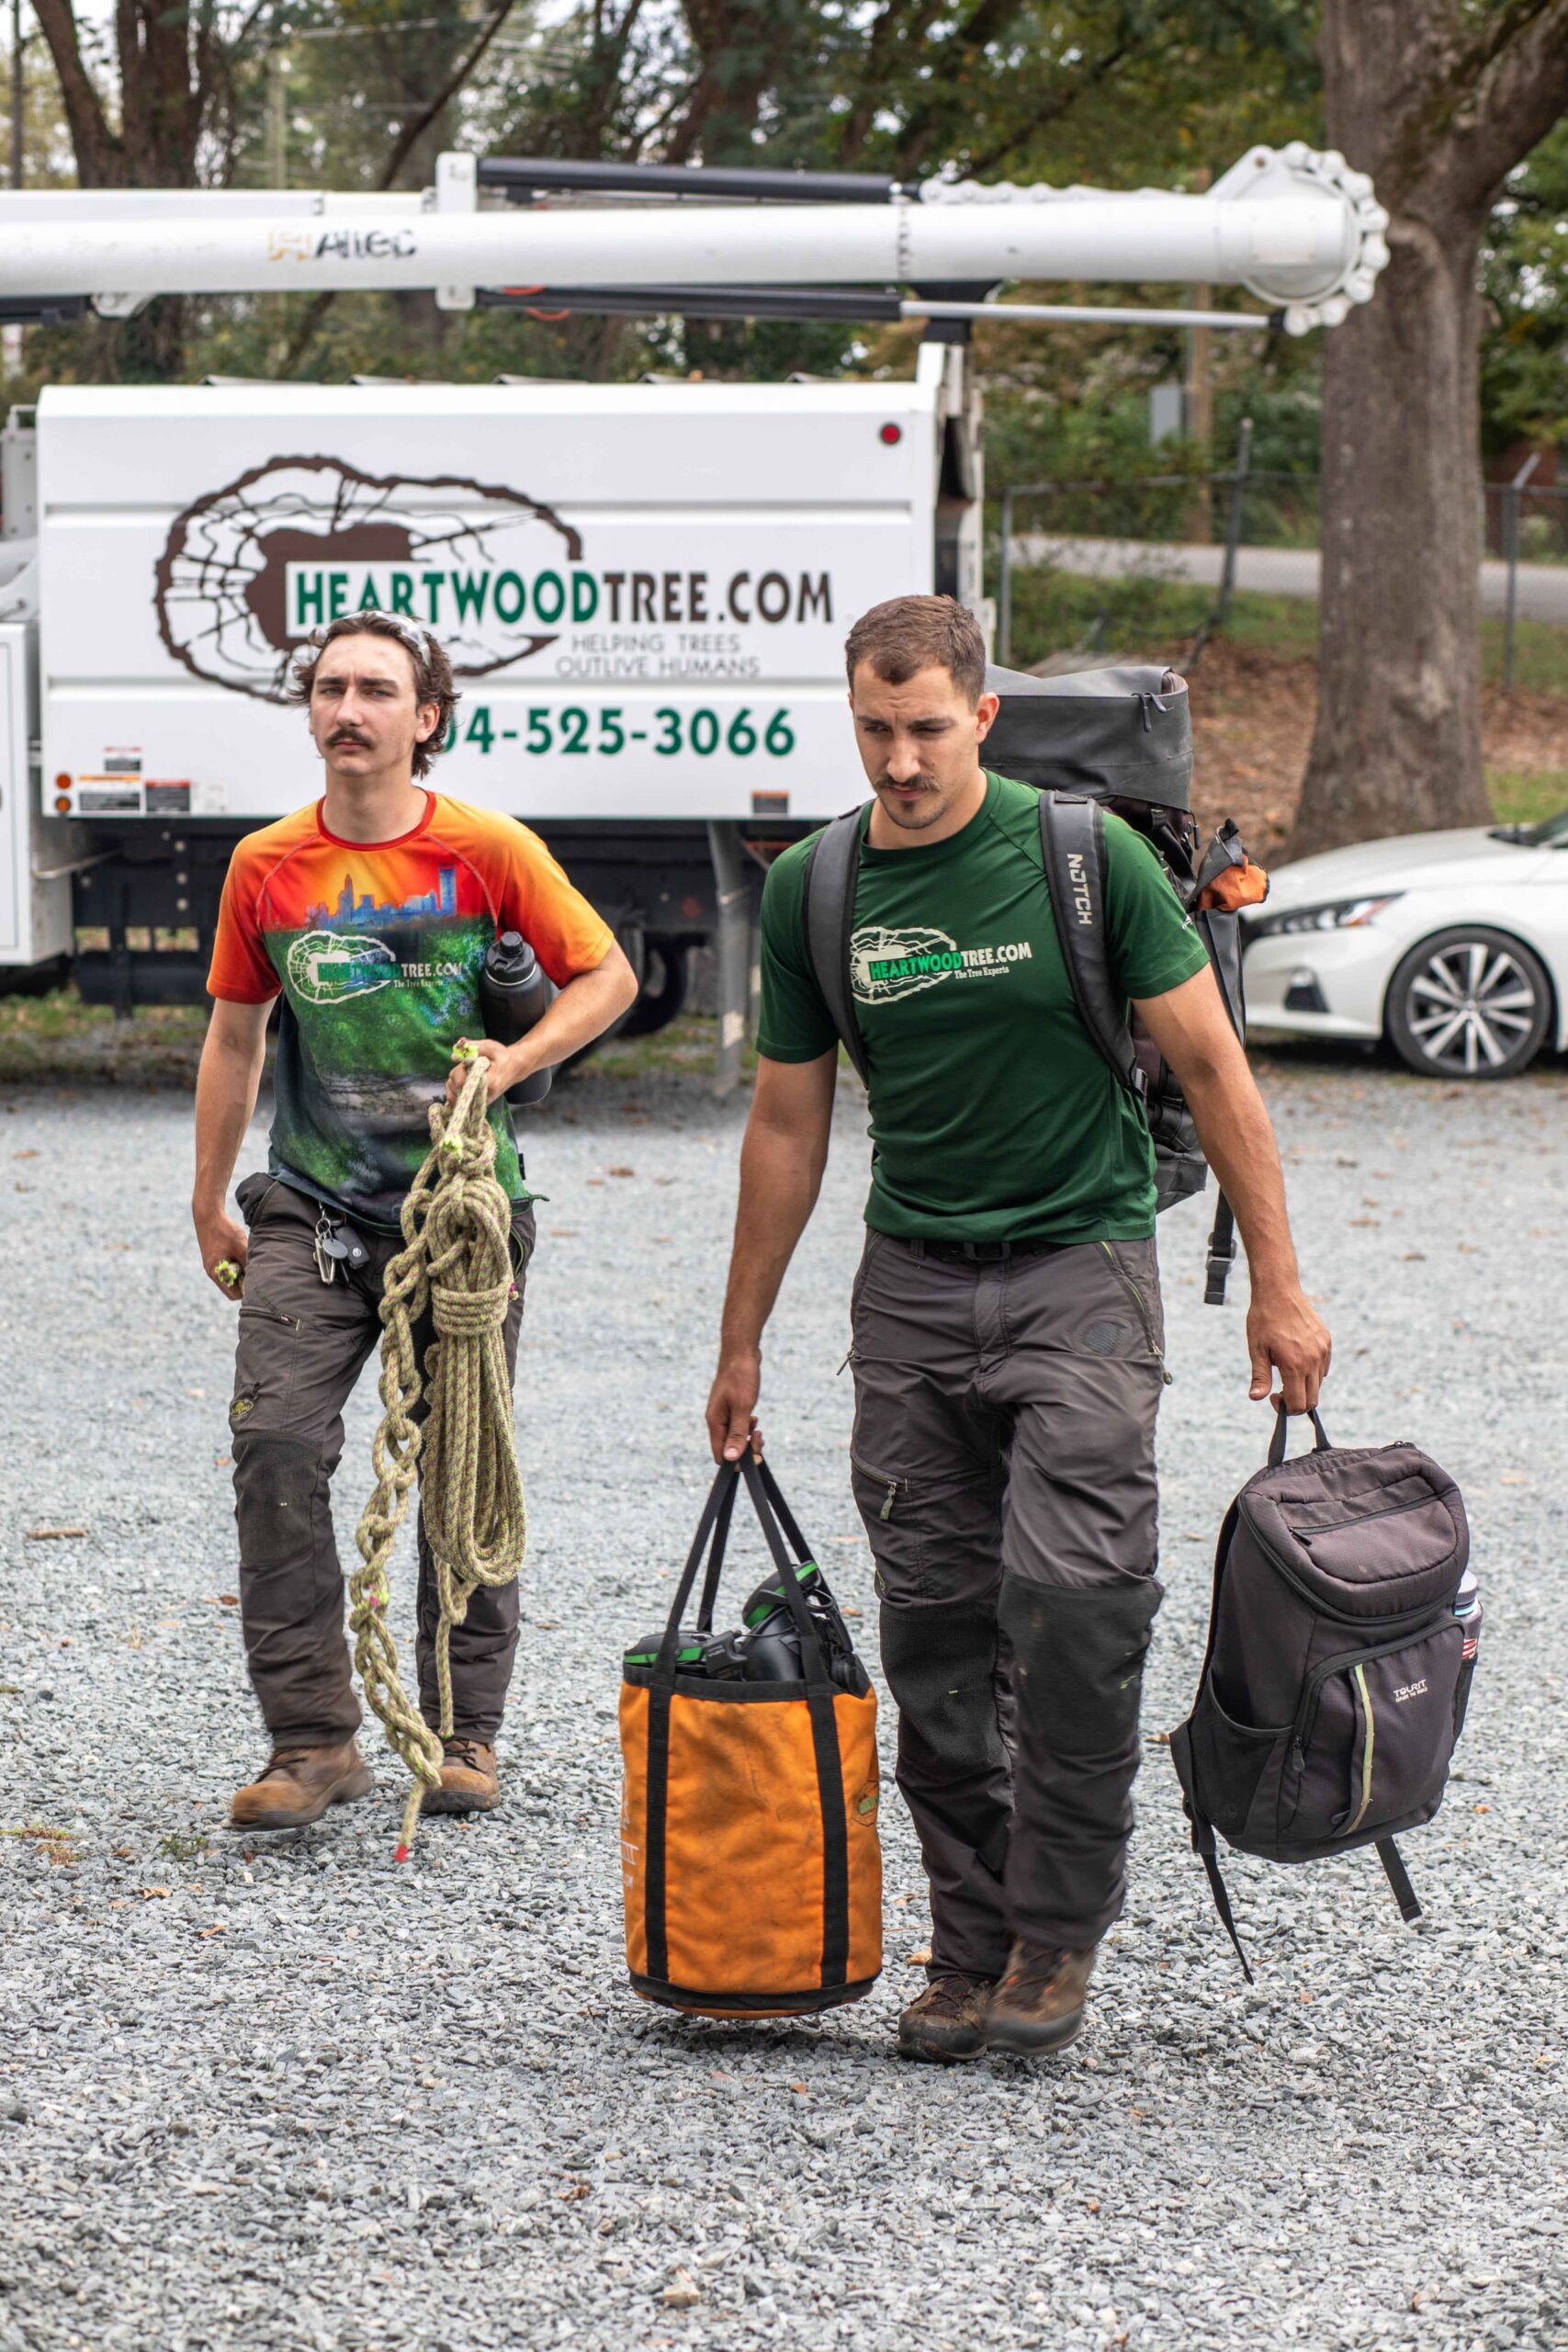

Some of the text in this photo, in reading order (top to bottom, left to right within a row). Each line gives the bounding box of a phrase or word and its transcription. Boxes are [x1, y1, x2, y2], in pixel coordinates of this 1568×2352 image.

[297, 569, 833, 625] HEARTWOODTREE.COM
[571, 633, 740, 653] HELPING TREES
[555, 656, 761, 677] OUTLIVE HUMANS
[1066, 854, 1093, 925] NOTCH
[871, 942, 1033, 980] HEARTWOODTREE.COM
[953, 966, 1010, 979] The Tree Experts
